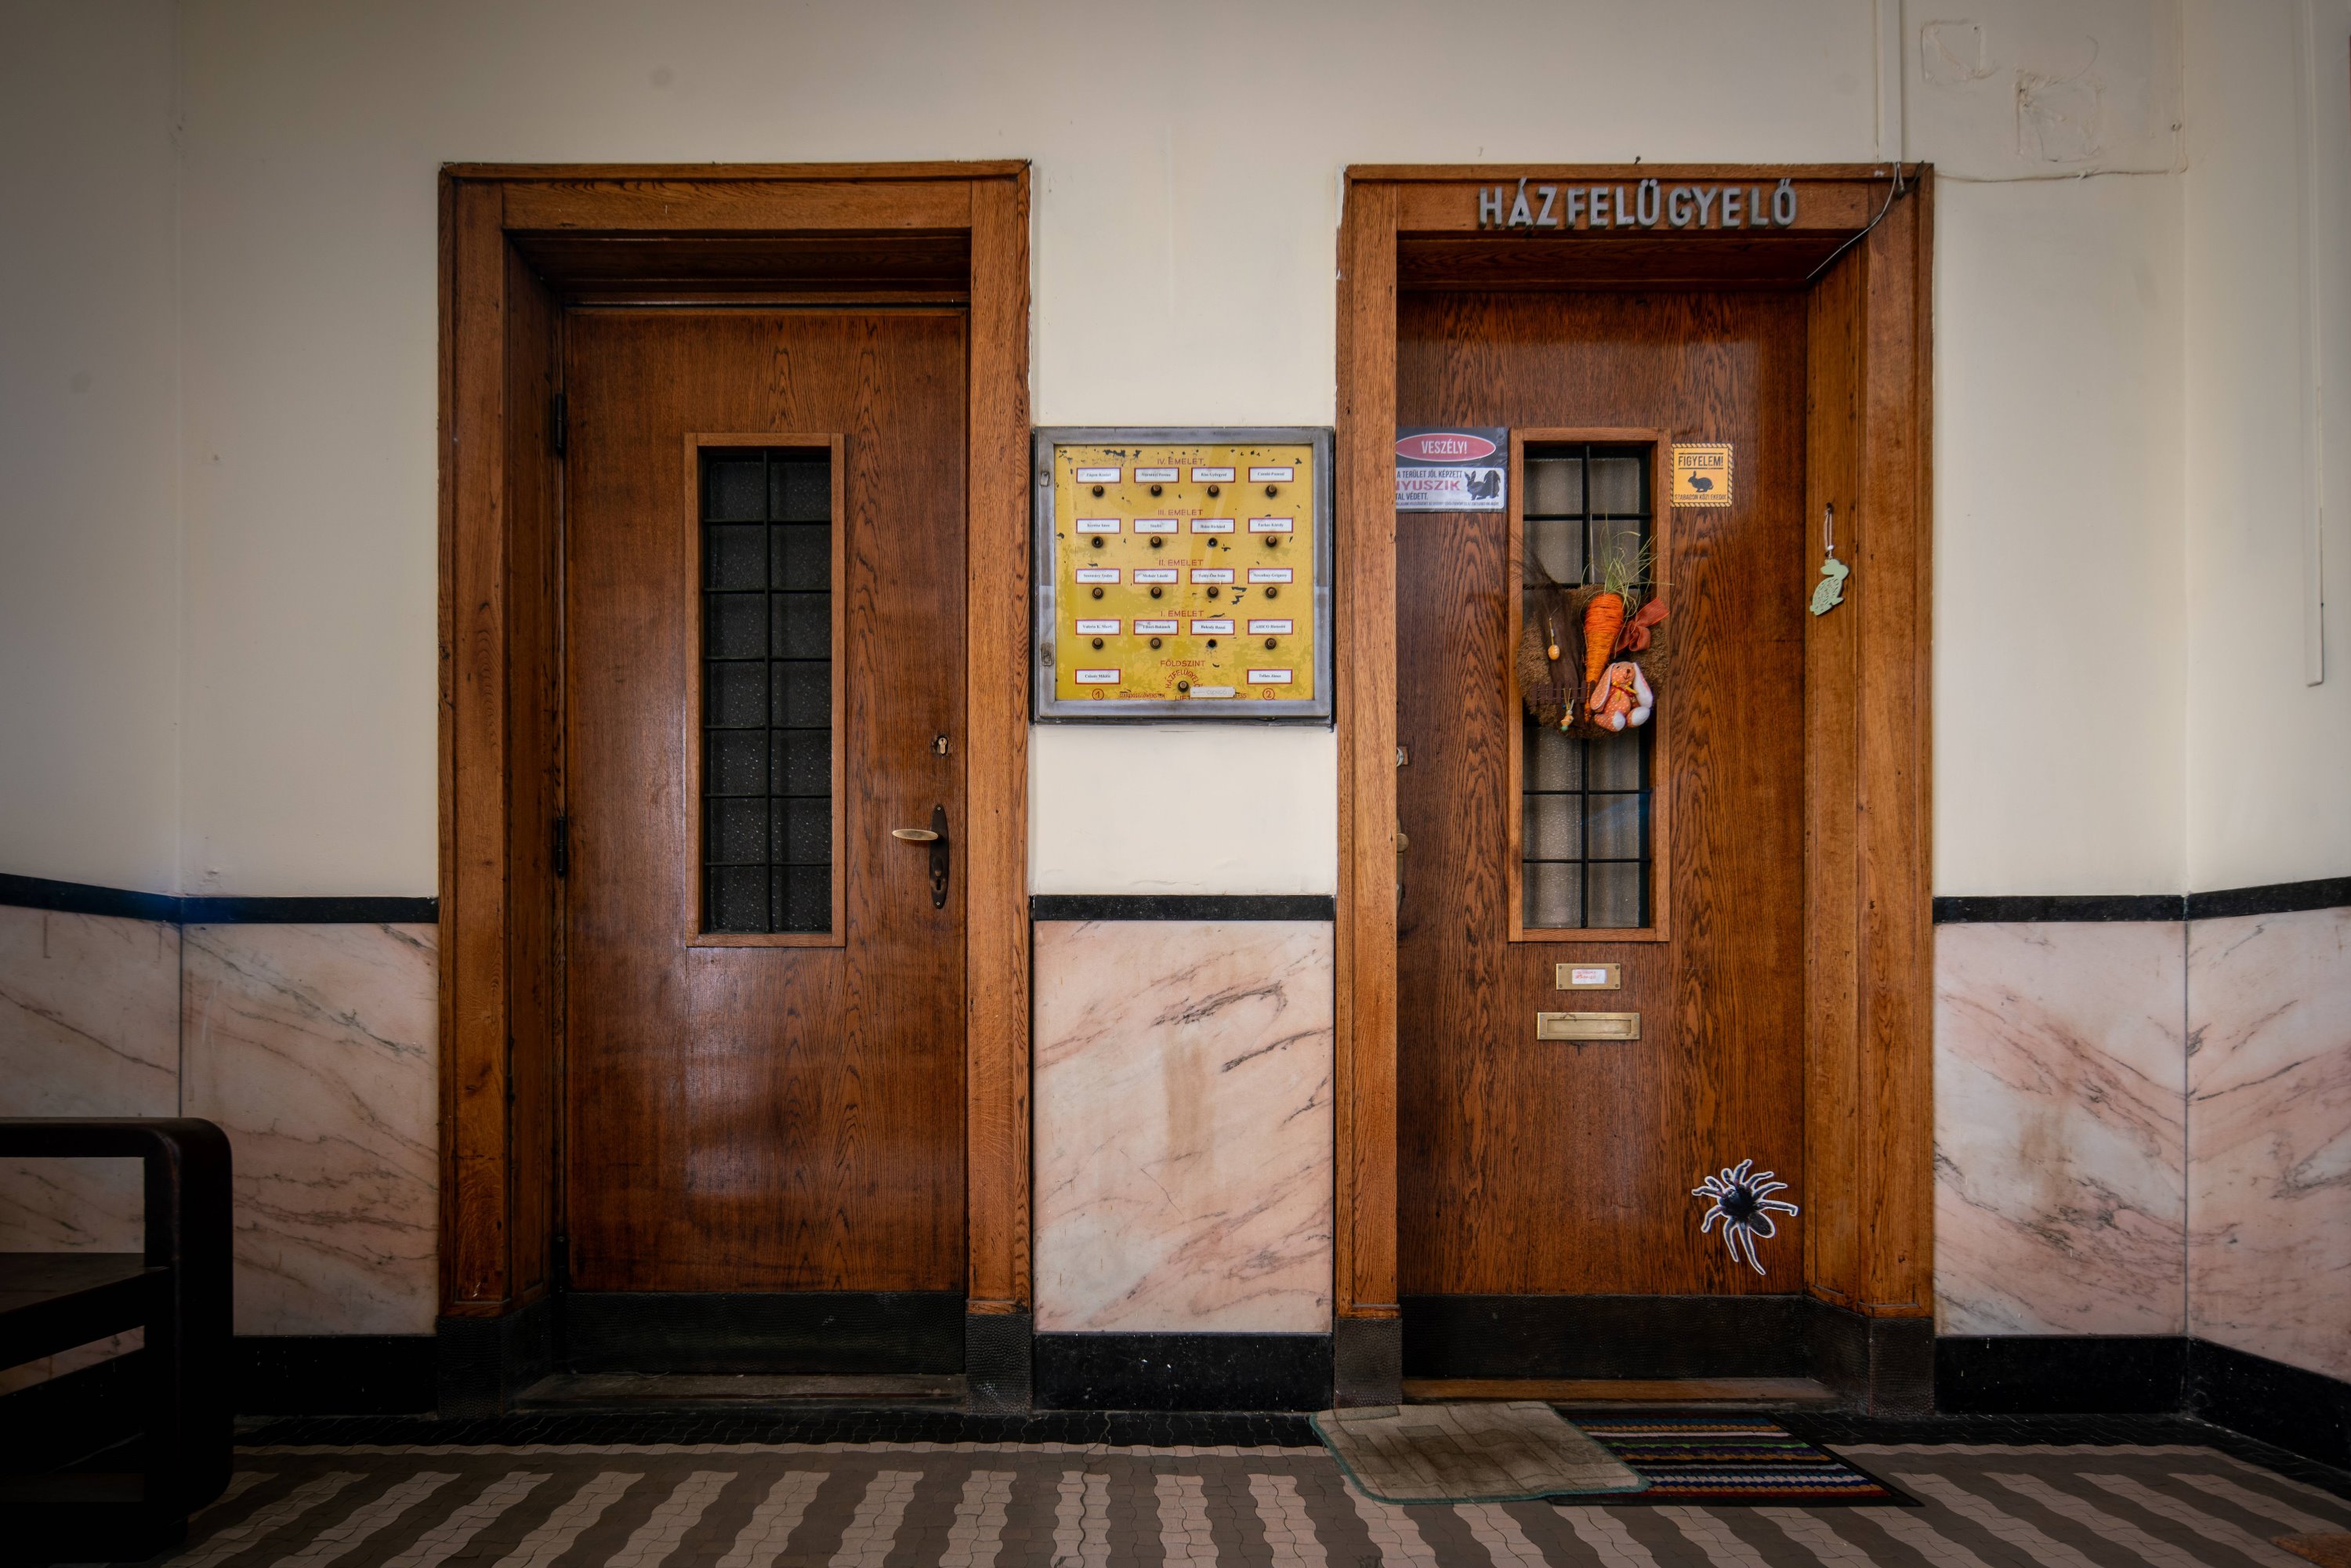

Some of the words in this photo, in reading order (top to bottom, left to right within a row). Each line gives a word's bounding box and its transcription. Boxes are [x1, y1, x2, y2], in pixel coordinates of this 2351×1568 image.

[1478, 177, 1797, 229] HÁZFELÜGYELŐ
[1421, 439, 1467, 454] VESZÉLY!
[1678, 455, 1724, 466] FIGYELEM!
[1402, 469, 1426, 478] TERÜLET
[1427, 469, 1437, 478] JÓL
[1438, 469, 1462, 478] KÉPZETT
[1406, 491, 1429, 500] VÉDETT.
